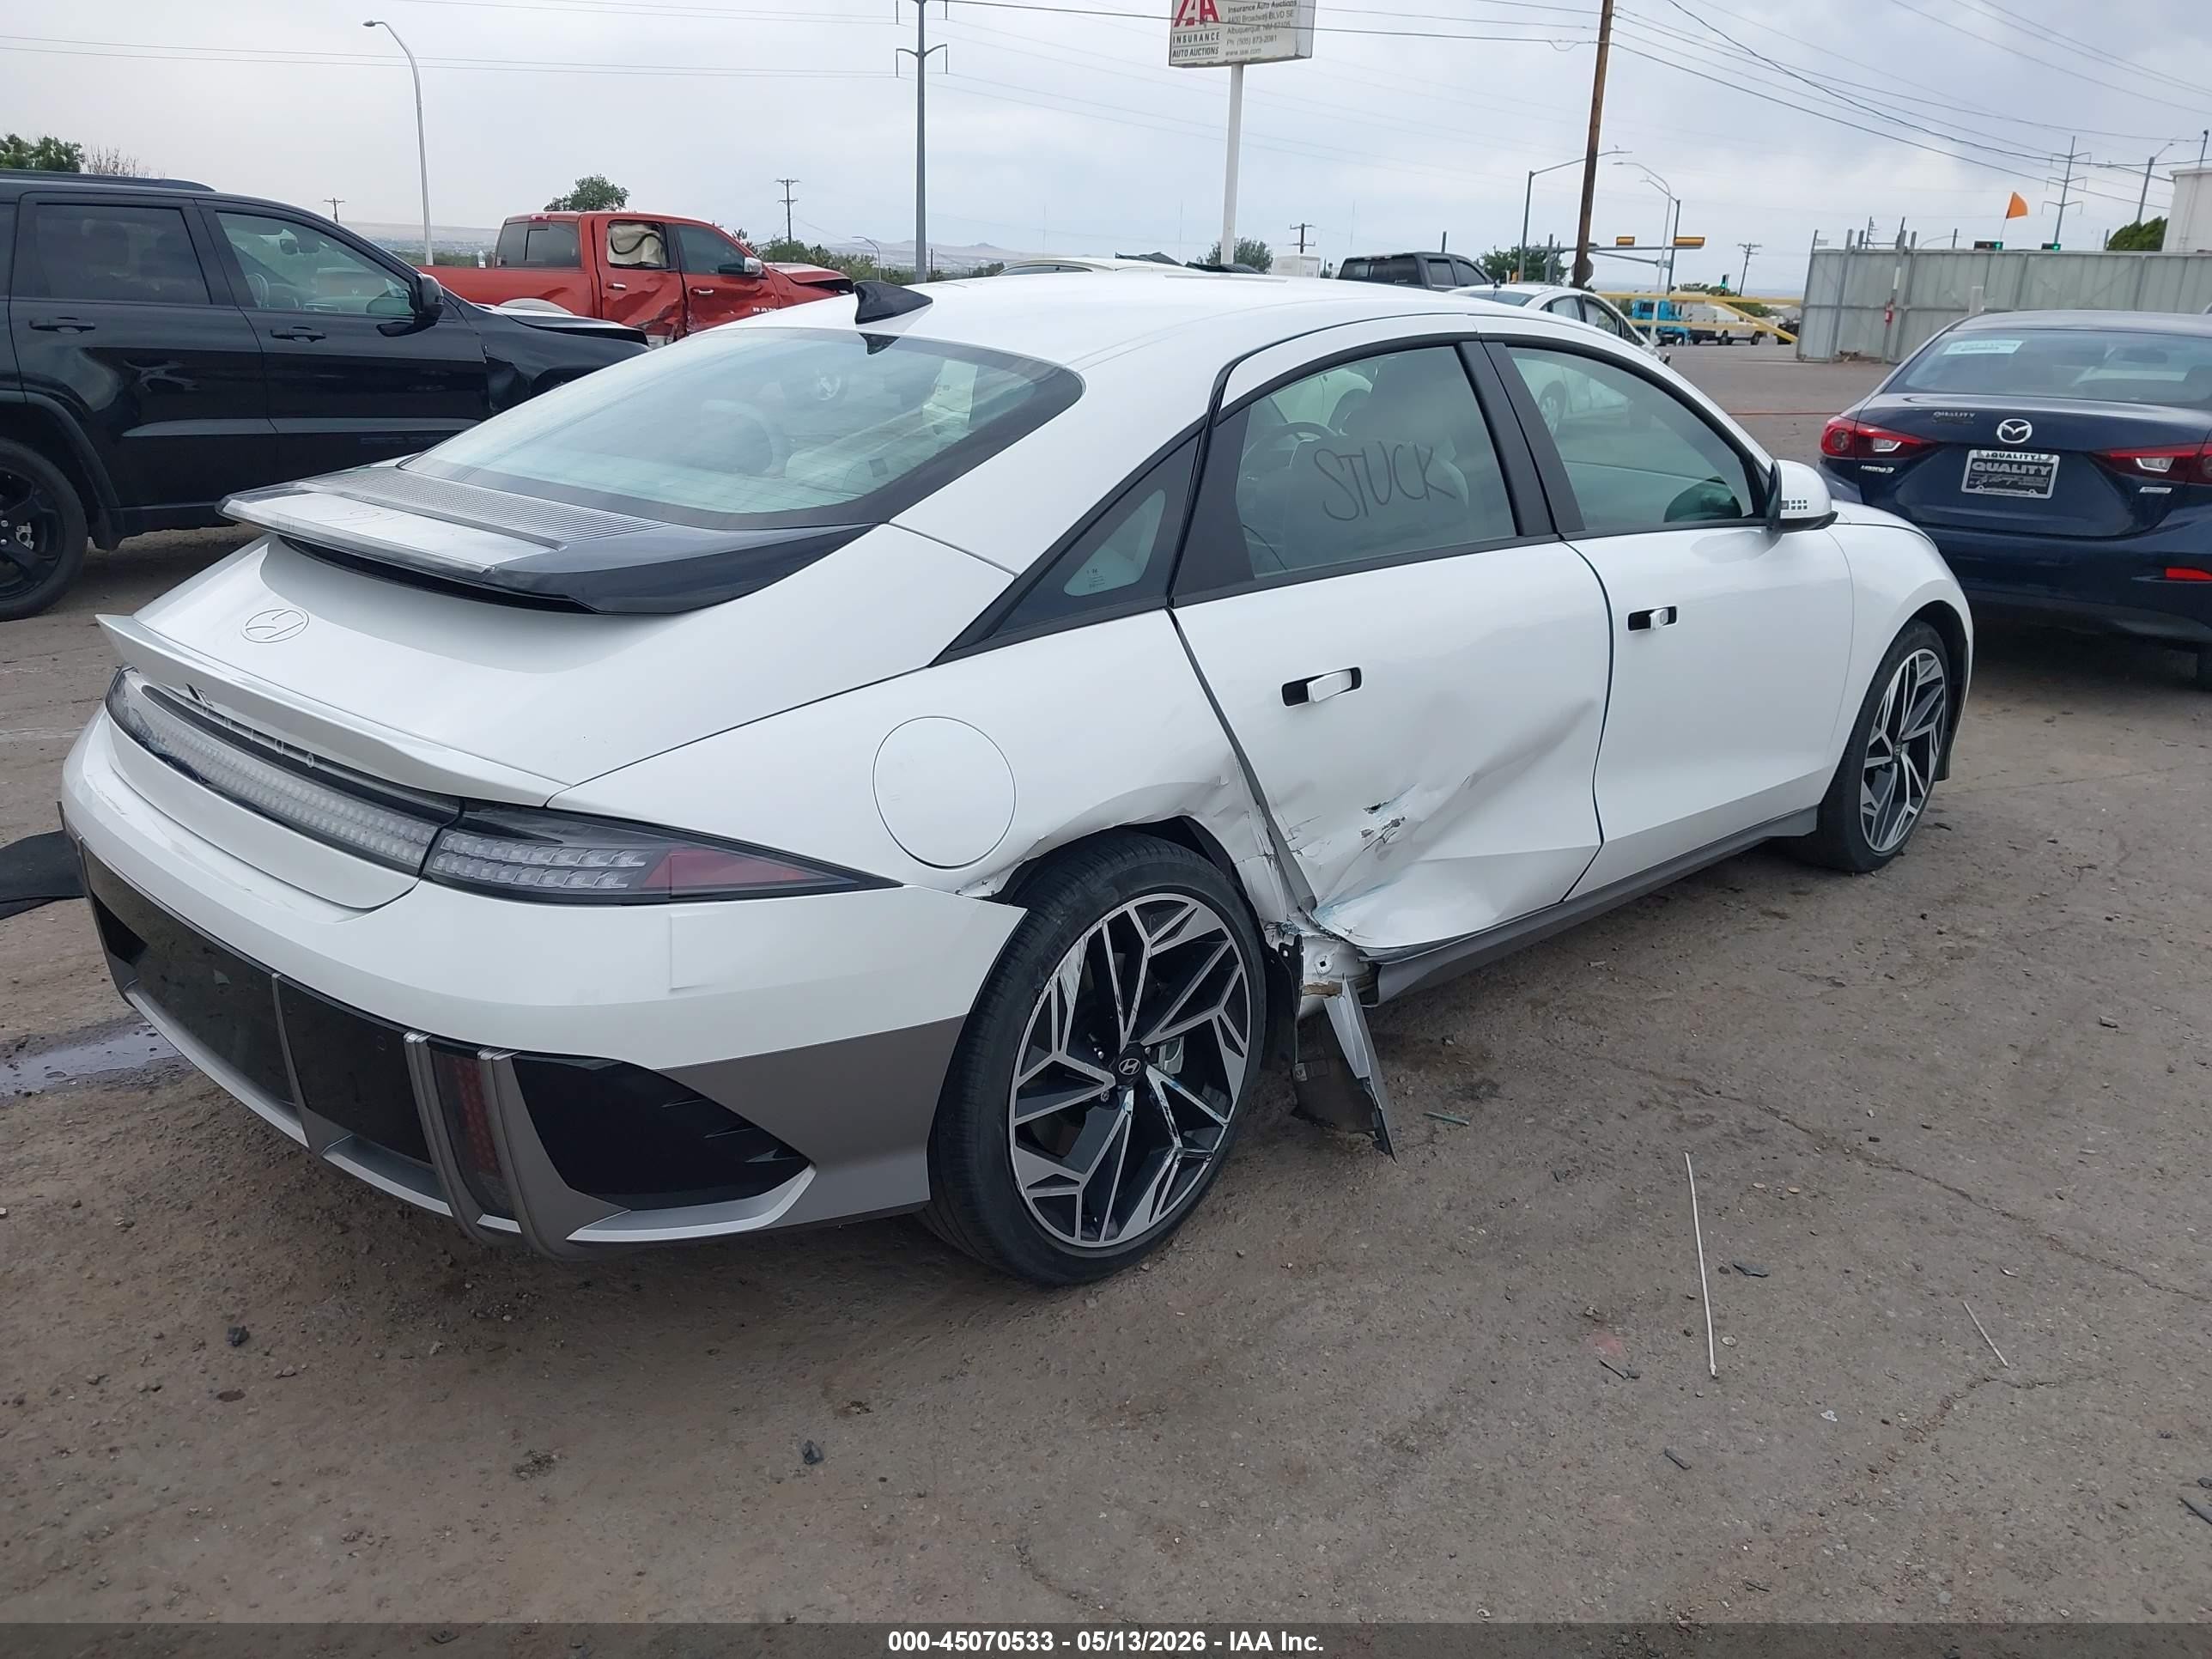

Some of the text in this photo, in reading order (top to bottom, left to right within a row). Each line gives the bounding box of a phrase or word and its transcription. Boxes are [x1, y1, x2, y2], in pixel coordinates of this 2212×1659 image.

[1228, 5, 1255, 14] Insurance
[1257, 1, 1269, 10] Auto
[1269, 10, 1285, 19] BLVD
[1173, 32, 1219, 44] INSURANCE
[1172, 46, 1219, 58] AUTO AUCTIONS
[1991, 452, 2038, 460] QUALITY
[1972, 461, 2052, 476] QUALITY
[1314, 441, 1456, 521] STUCK
